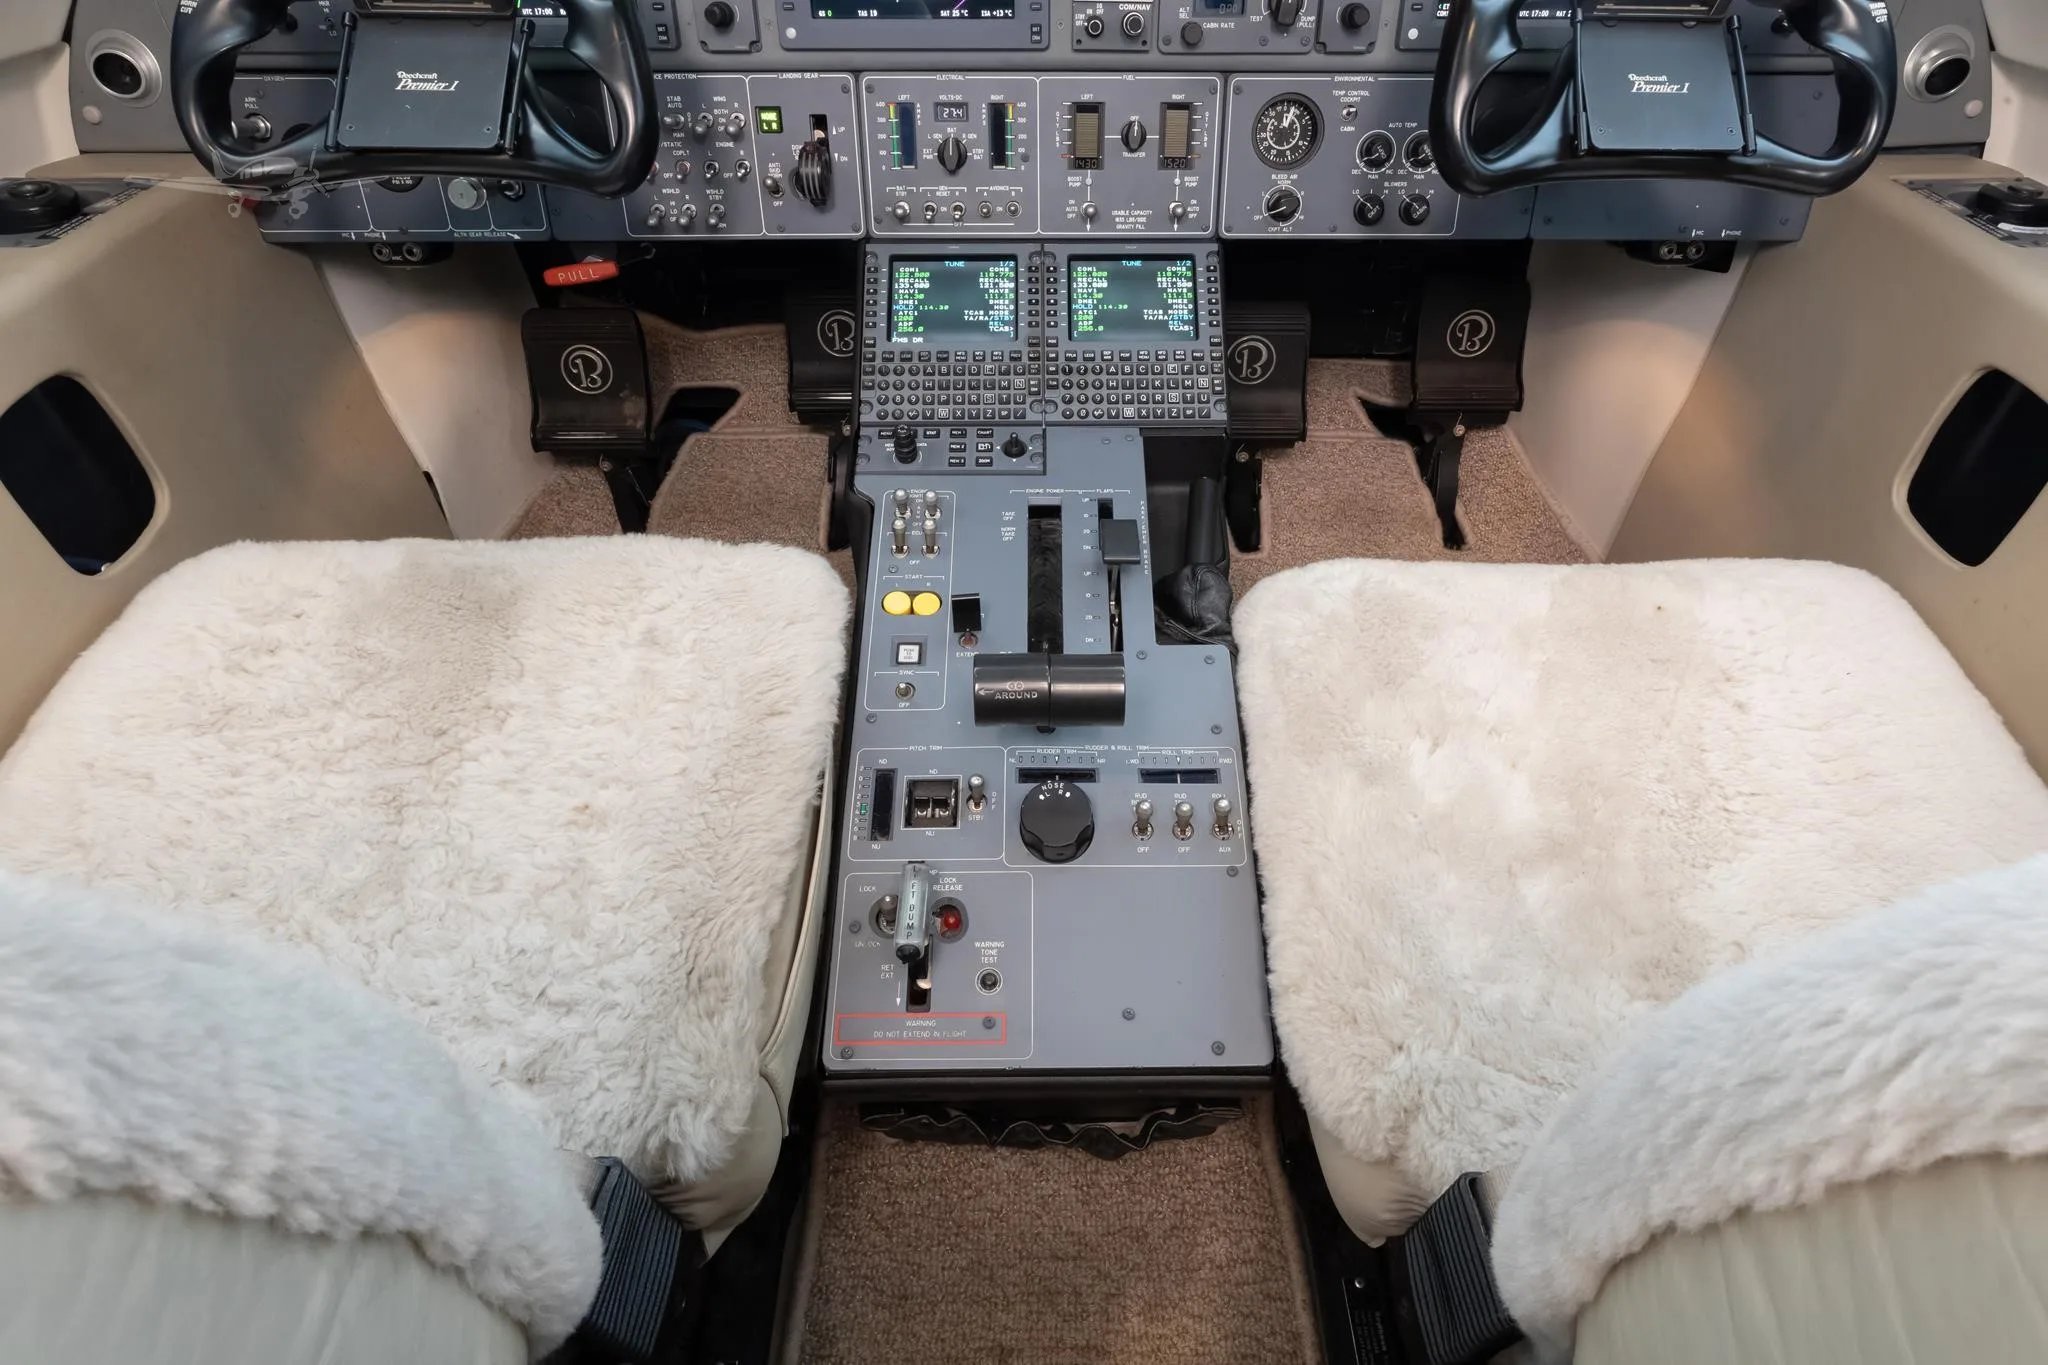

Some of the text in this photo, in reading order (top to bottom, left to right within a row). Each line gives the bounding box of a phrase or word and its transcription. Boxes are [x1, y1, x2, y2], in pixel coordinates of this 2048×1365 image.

[395, 79, 449, 90] Premier
[1631, 81, 1680, 92] Premier
[1075, 158, 1097, 168] 1430
[1164, 158, 1186, 168] 1520
[558, 269, 599, 284] PULL
[995, 691, 1038, 699] AROUND
[1041, 782, 1064, 790] NOSE
